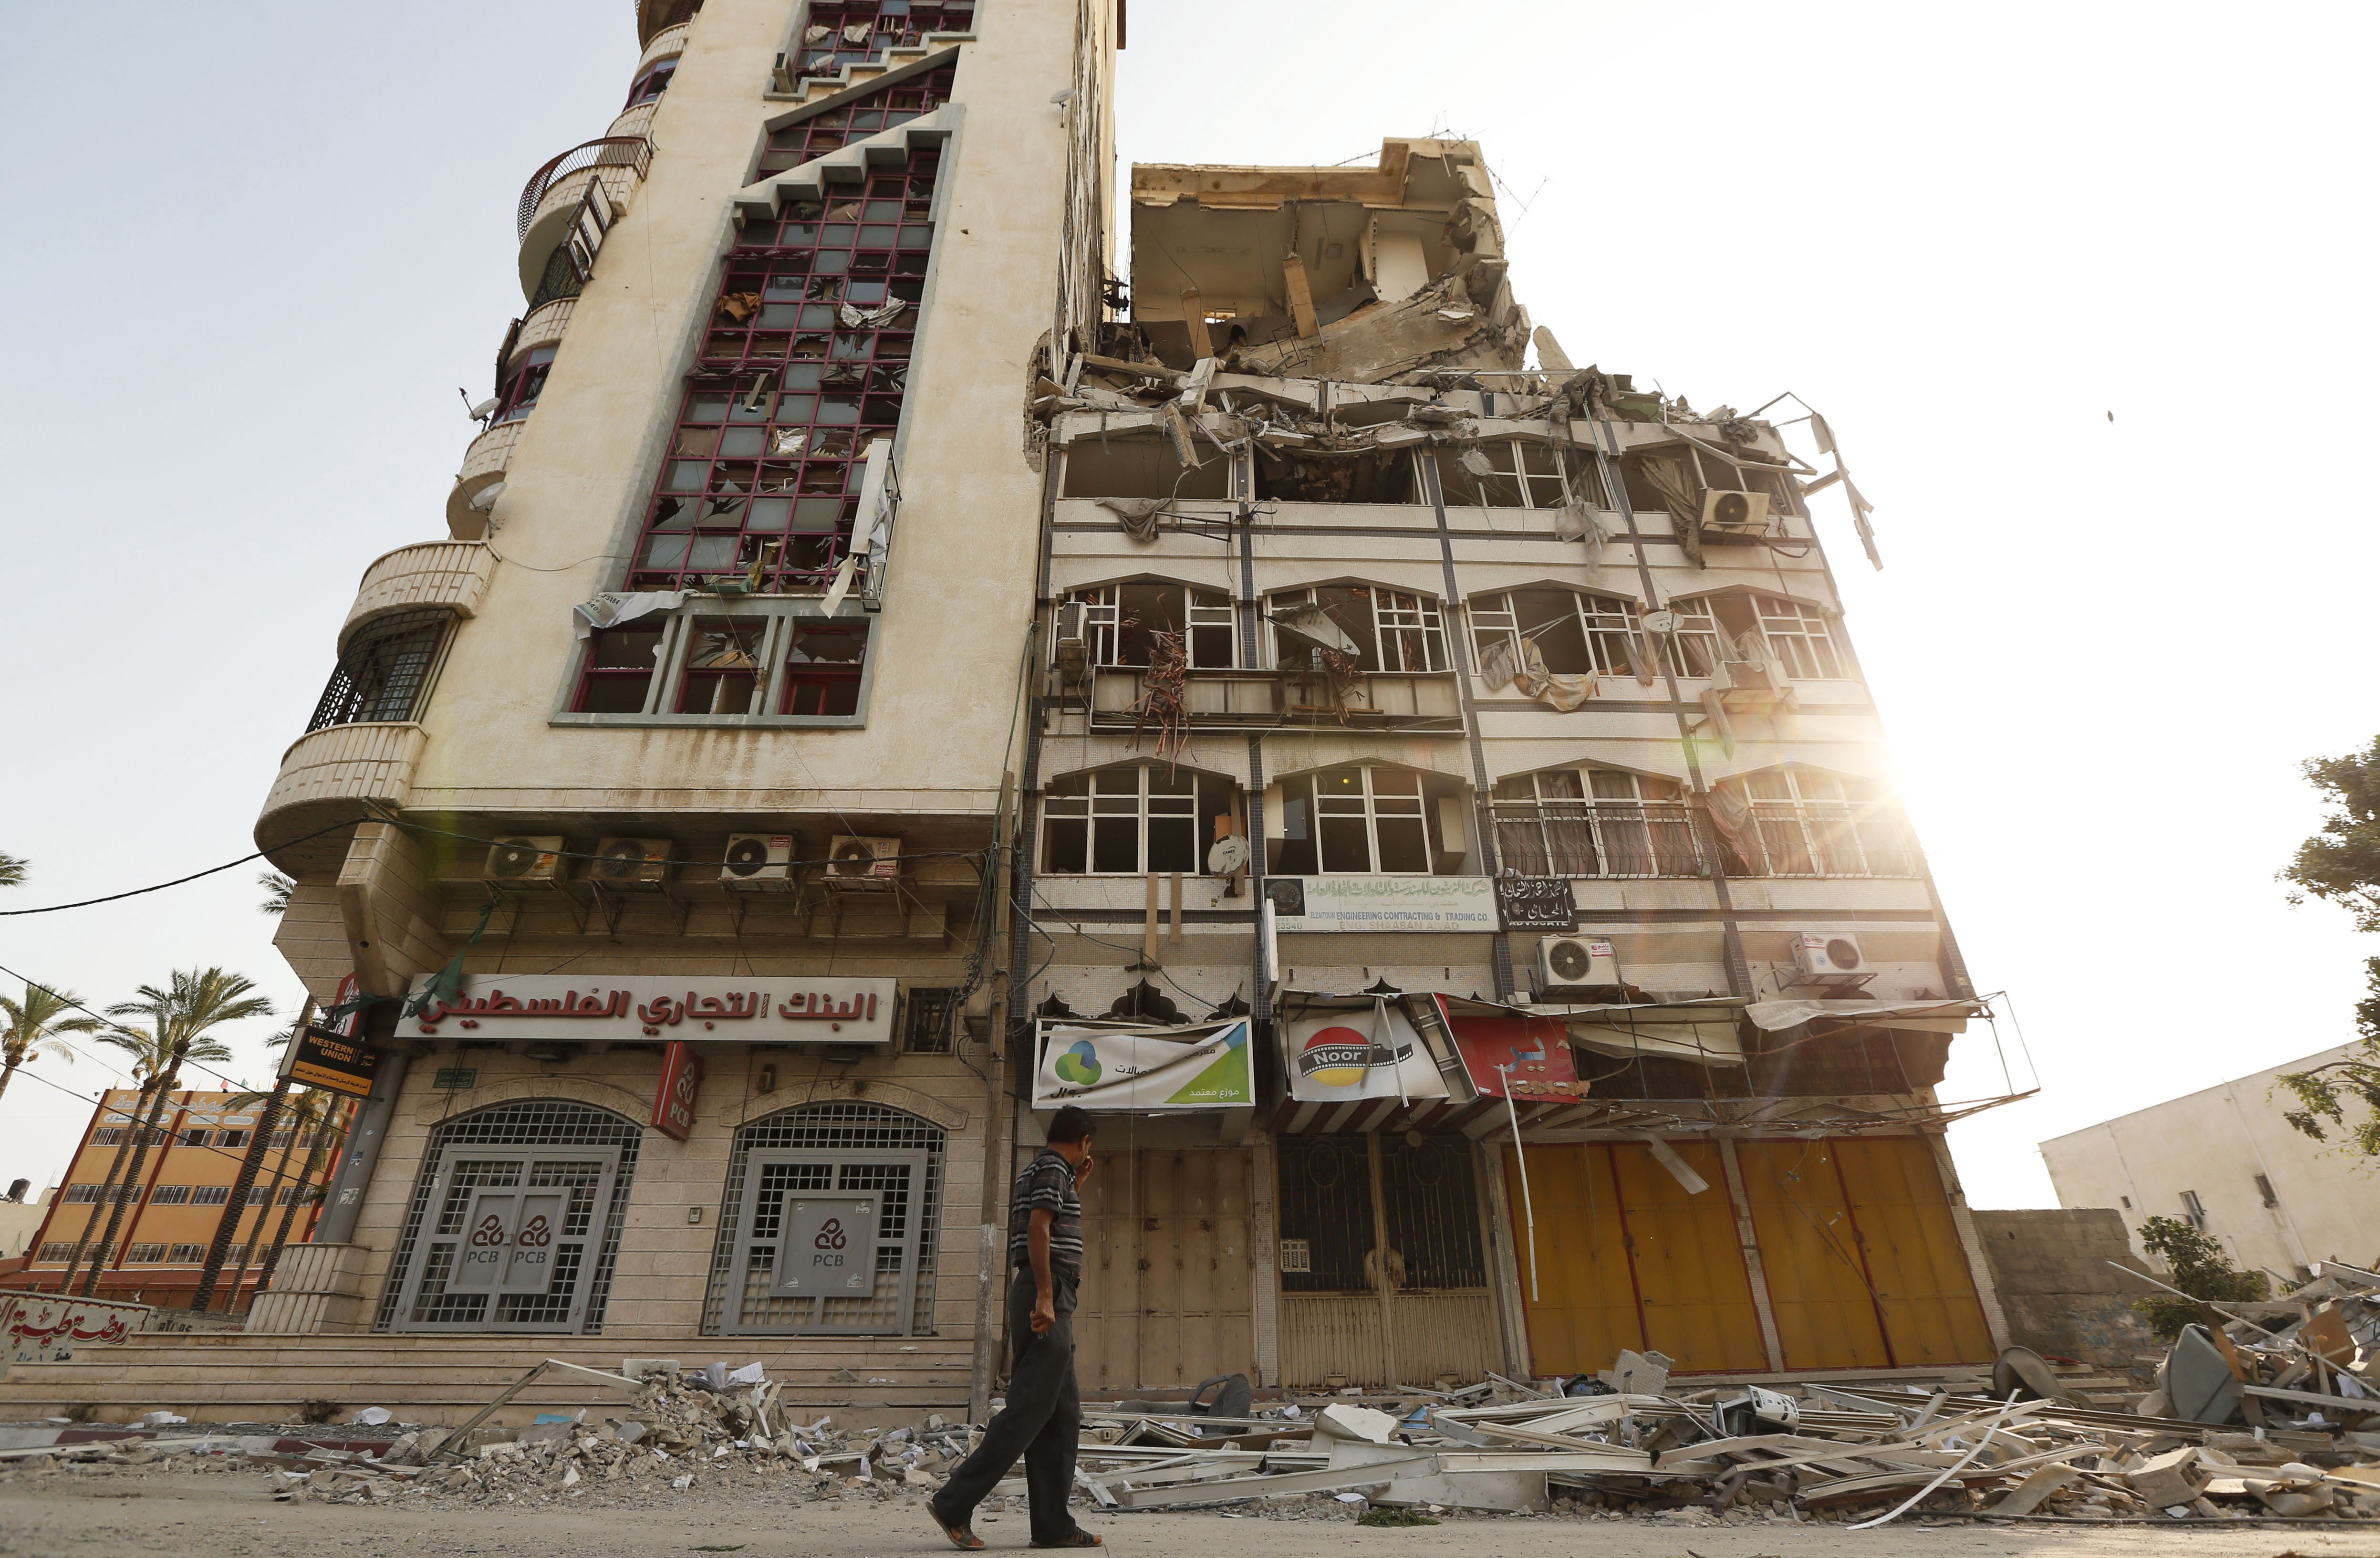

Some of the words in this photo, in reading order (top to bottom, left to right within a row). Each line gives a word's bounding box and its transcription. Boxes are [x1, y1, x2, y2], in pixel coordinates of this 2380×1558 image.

[1336, 912, 1382, 920] ENGINEERING
[1384, 912, 1434, 920] CONTRACTING
[1435, 912, 1441, 920] &
[1445, 912, 1476, 921] TRADING
[1477, 913, 1489, 921] CO.
[1340, 921, 1365, 930] ENG.
[1369, 921, 1422, 930] SHAABAN
[417, 988, 631, 1034] الفلسطيني
[637, 991, 770, 1035] التجاري
[778, 992, 876, 1031] البنك
[309, 1035, 354, 1055] WESTERN
[321, 1048, 352, 1063] UNION
[1313, 1051, 1362, 1065] Noor
[1189, 1088, 1216, 1097] معتمد
[1219, 1088, 1239, 1099] موزع
[669, 1101, 689, 1128] PCB
[467, 1251, 499, 1264] PCB
[514, 1251, 547, 1264] PCB
[812, 1254, 844, 1267] PCB
[8, 1306, 73, 1348] طيبة
[69, 1314, 134, 1345] روضة
